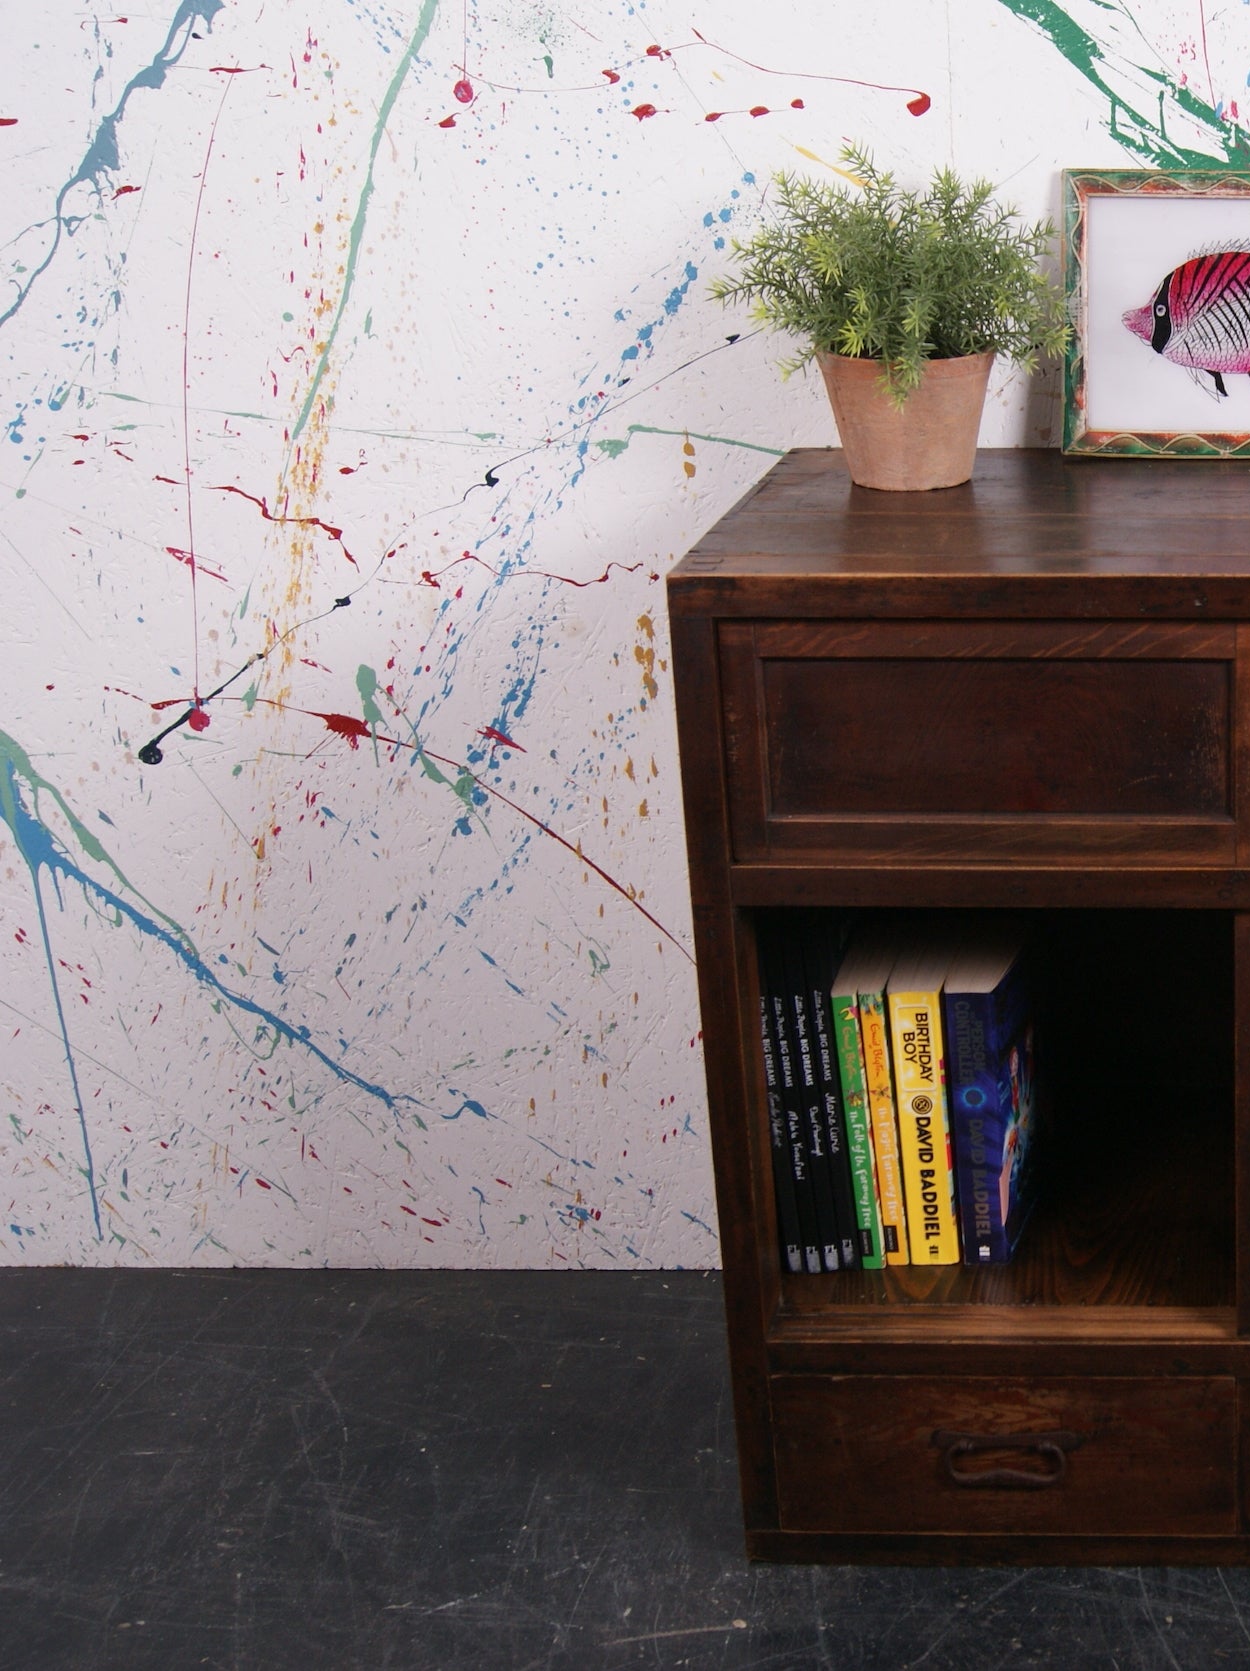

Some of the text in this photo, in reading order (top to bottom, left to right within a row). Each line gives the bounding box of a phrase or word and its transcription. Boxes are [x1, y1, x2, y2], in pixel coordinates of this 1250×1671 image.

[800, 1039, 809, 1053] BIG
[819, 1033, 828, 1048] BIG
[903, 1031, 918, 1064] BOY
[915, 1012, 933, 1083] BIRTHDAY
[764, 1054, 776, 1086] DREAMS
[782, 1056, 793, 1087] DREAMS
[802, 1054, 814, 1087] DREAMS
[821, 1049, 832, 1080] DREAMS
[852, 1124, 864, 1143] Folk
[855, 1169, 869, 1205] Faraway
[915, 1116, 940, 1240] DAVID BADDIEL
[969, 1119, 991, 1238] DAVID BADDIEL
[862, 1207, 871, 1227] Tree
